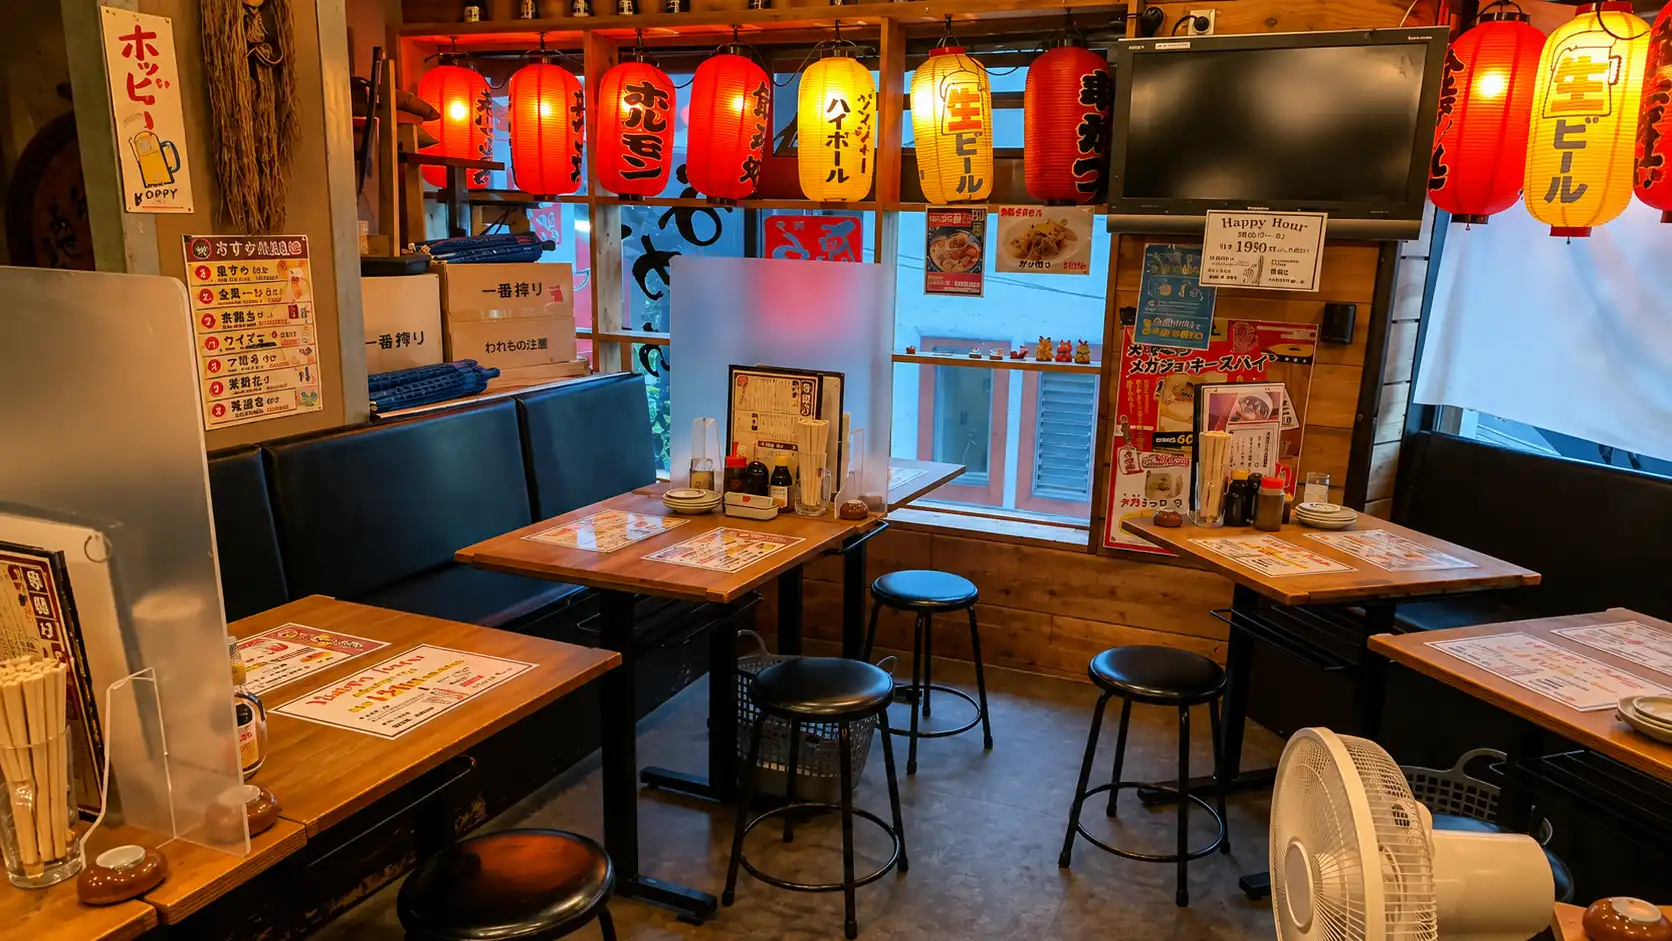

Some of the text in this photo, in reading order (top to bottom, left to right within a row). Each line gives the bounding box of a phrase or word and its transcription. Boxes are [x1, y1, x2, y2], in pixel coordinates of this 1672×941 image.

[620, 80, 669, 181] ホルモン
[825, 98, 850, 184] ハイボール
[947, 86, 984, 195] 生ビール
[1544, 56, 1610, 203] 生ビール
[1222, 217, 1308, 232] Happy Hour
